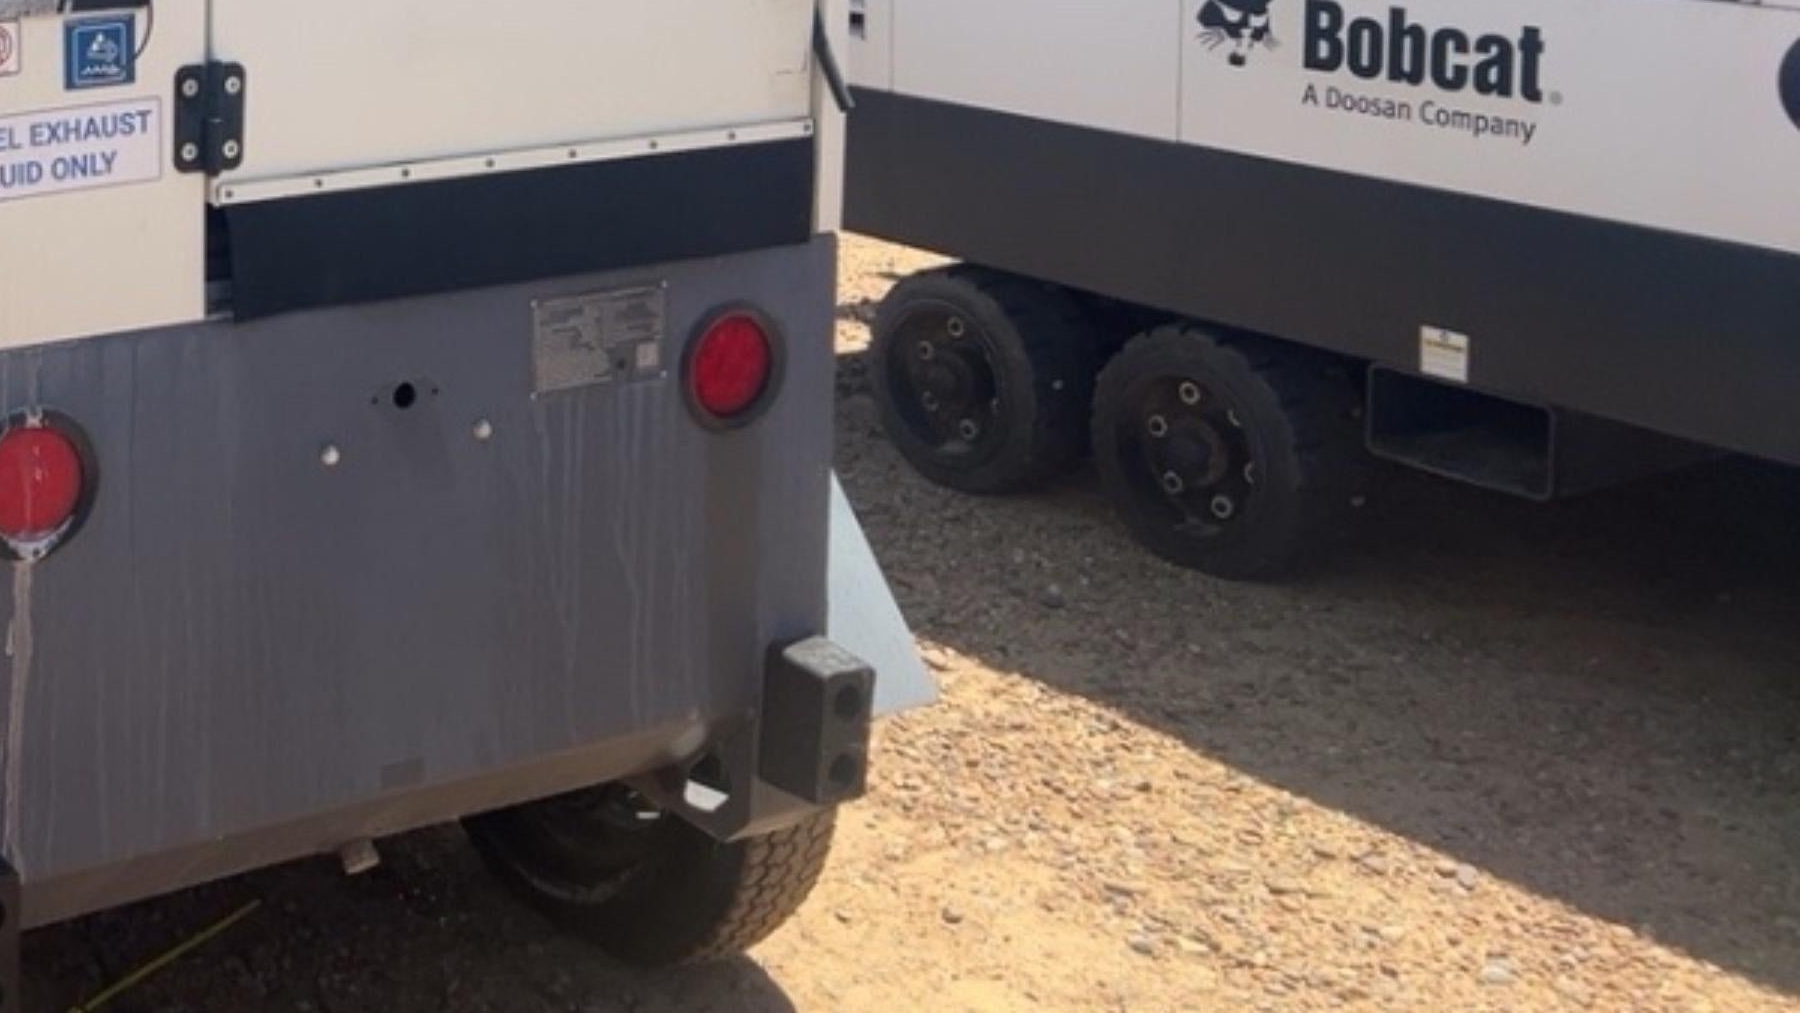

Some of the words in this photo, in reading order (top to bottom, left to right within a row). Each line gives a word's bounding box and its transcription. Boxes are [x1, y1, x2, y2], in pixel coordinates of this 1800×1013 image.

[29, 109, 152, 148] EXHAUST
[1302, 84, 1319, 106] A
[1325, 86, 1412, 121] Doosan
[1419, 99, 1537, 146] Company
[51, 151, 118, 181] ONLY
